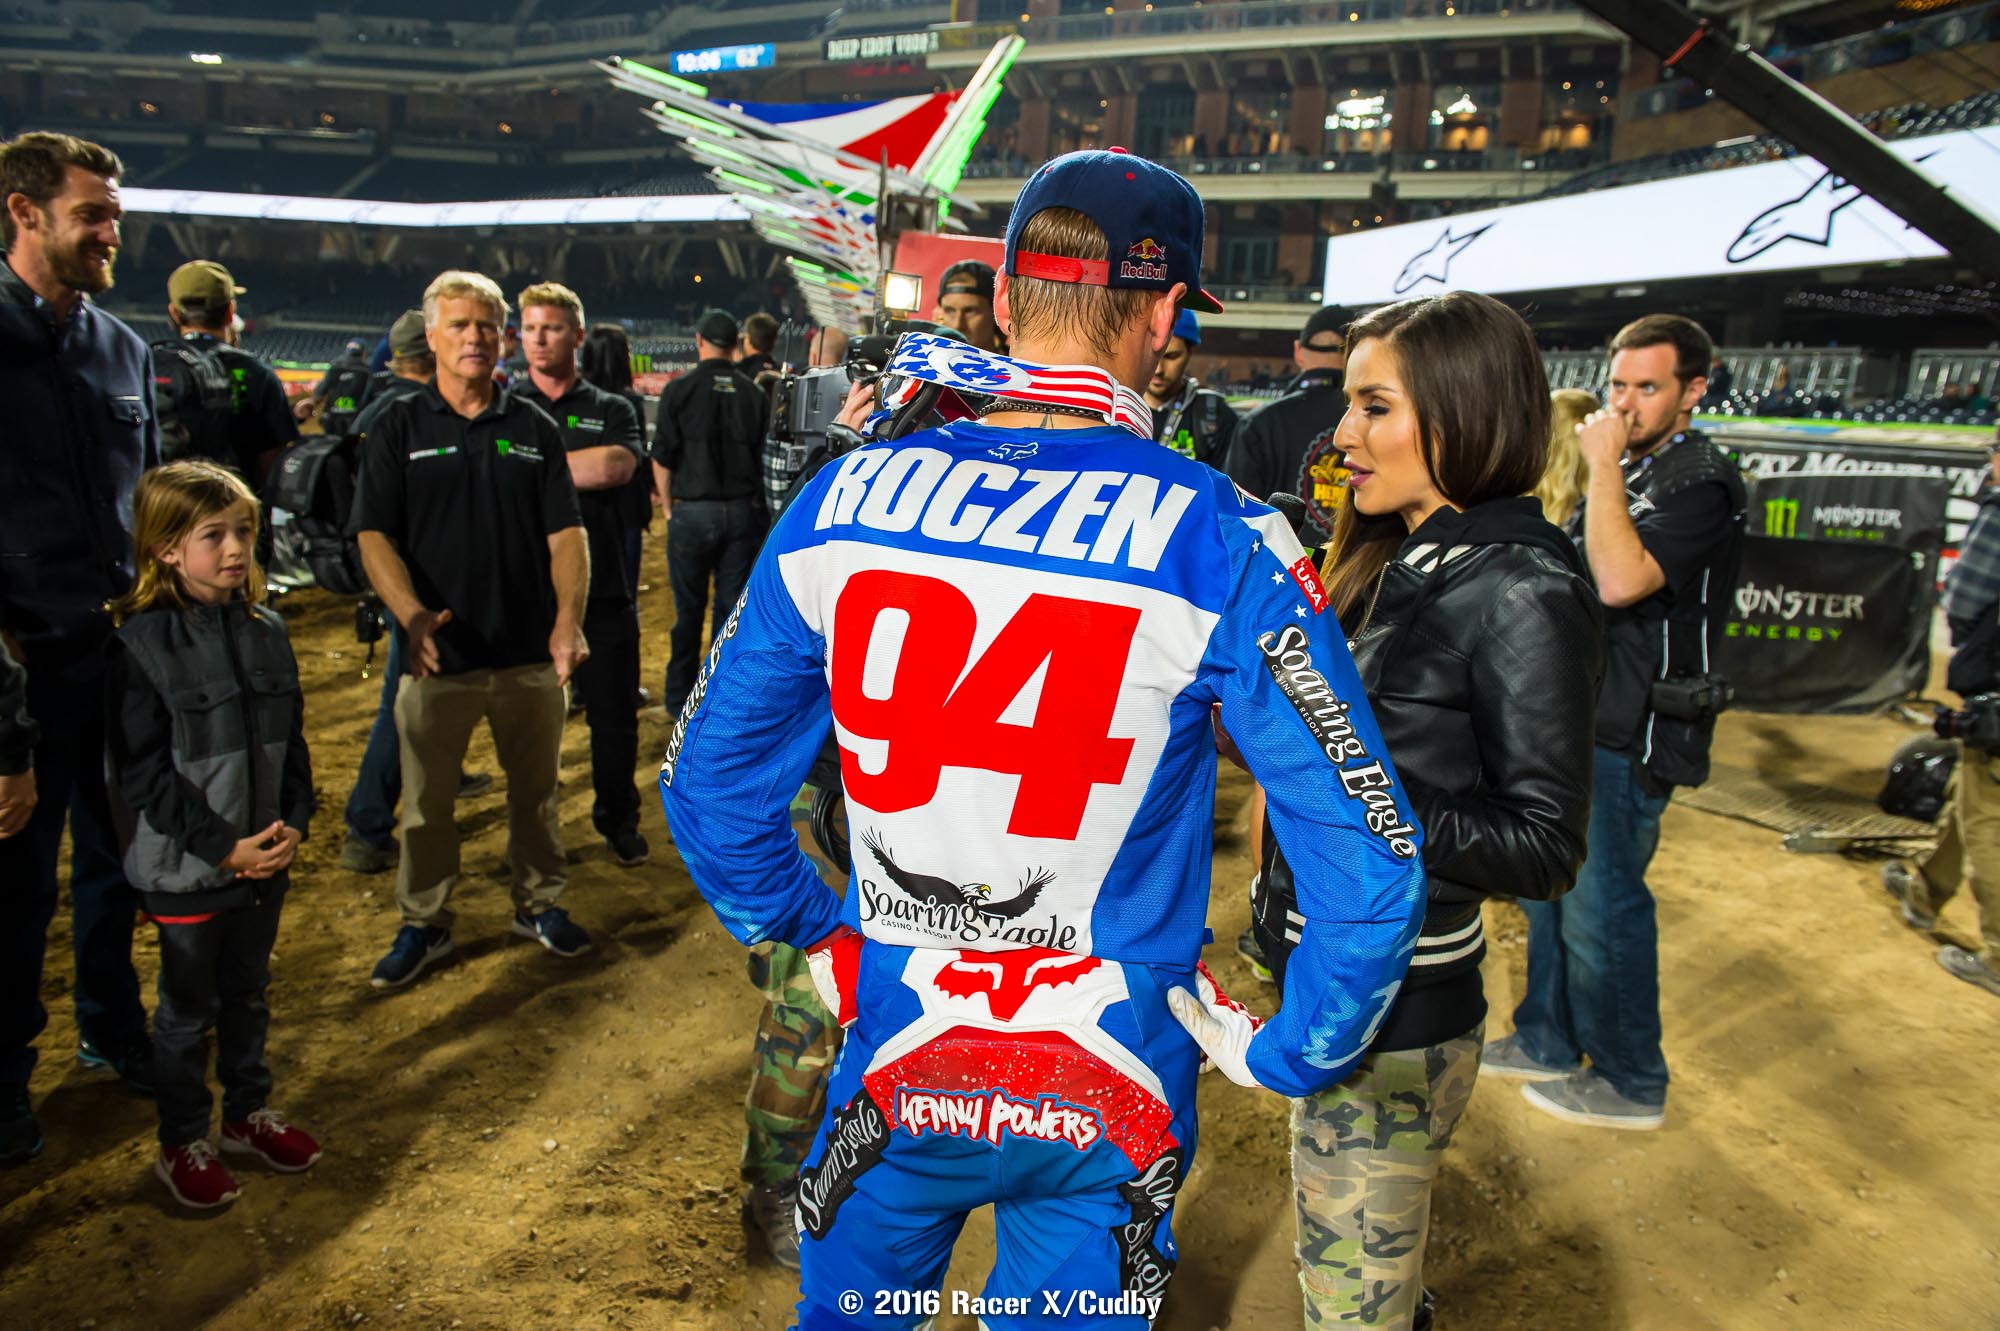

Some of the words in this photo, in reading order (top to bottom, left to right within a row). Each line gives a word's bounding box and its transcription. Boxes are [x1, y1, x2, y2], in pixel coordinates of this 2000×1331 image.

[1120, 261, 1145, 278] Red
[1146, 262, 1167, 280] Bull
[815, 448, 1197, 572] ROCZEN
[1296, 566, 1322, 607] USA
[1735, 581, 1864, 620] ONSTER
[1725, 622, 1843, 641] ENERGY
[830, 569, 1142, 840] 94
[1271, 664, 1294, 697] CASINO
[1299, 706, 1324, 738] RESORT
[1259, 626, 1366, 763] Soaring
[1339, 761, 1417, 856] Eagle
[860, 879, 981, 942] Soaring
[881, 918, 912, 931] CASINO
[923, 928, 953, 941] RESORT
[900, 1094, 983, 1138] KENNY
[987, 1093, 1099, 1149] POWERS
